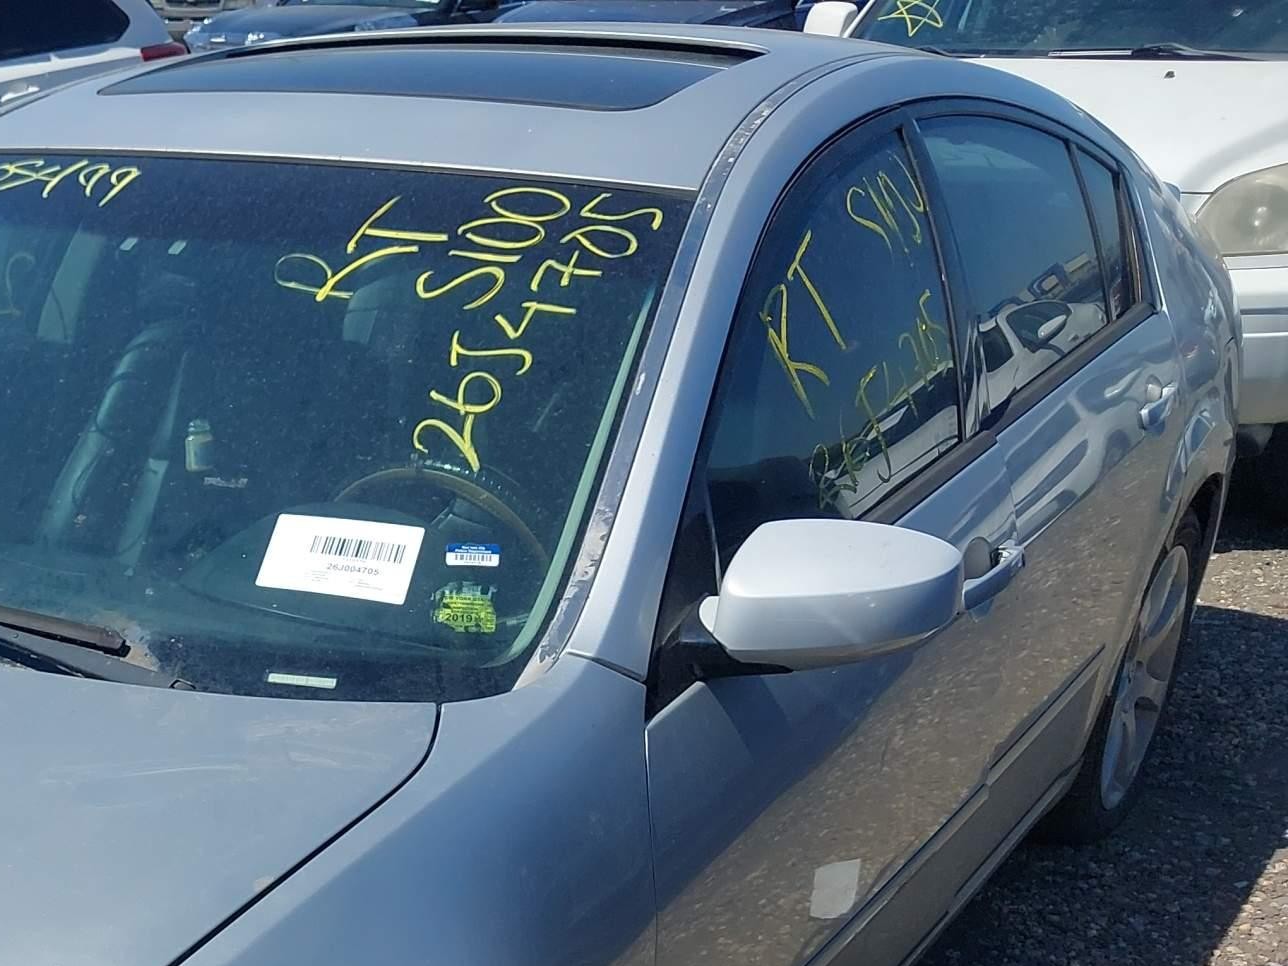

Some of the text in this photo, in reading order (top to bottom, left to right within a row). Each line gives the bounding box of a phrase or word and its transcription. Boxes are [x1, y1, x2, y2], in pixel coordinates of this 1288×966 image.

[273, 195, 449, 302] RT
[415, 187, 572, 310] S100
[413, 193, 664, 472] 26J4705
[758, 229, 847, 420] RT
[326, 562, 381, 577] 26J004705
[445, 612, 473, 623] 2019
